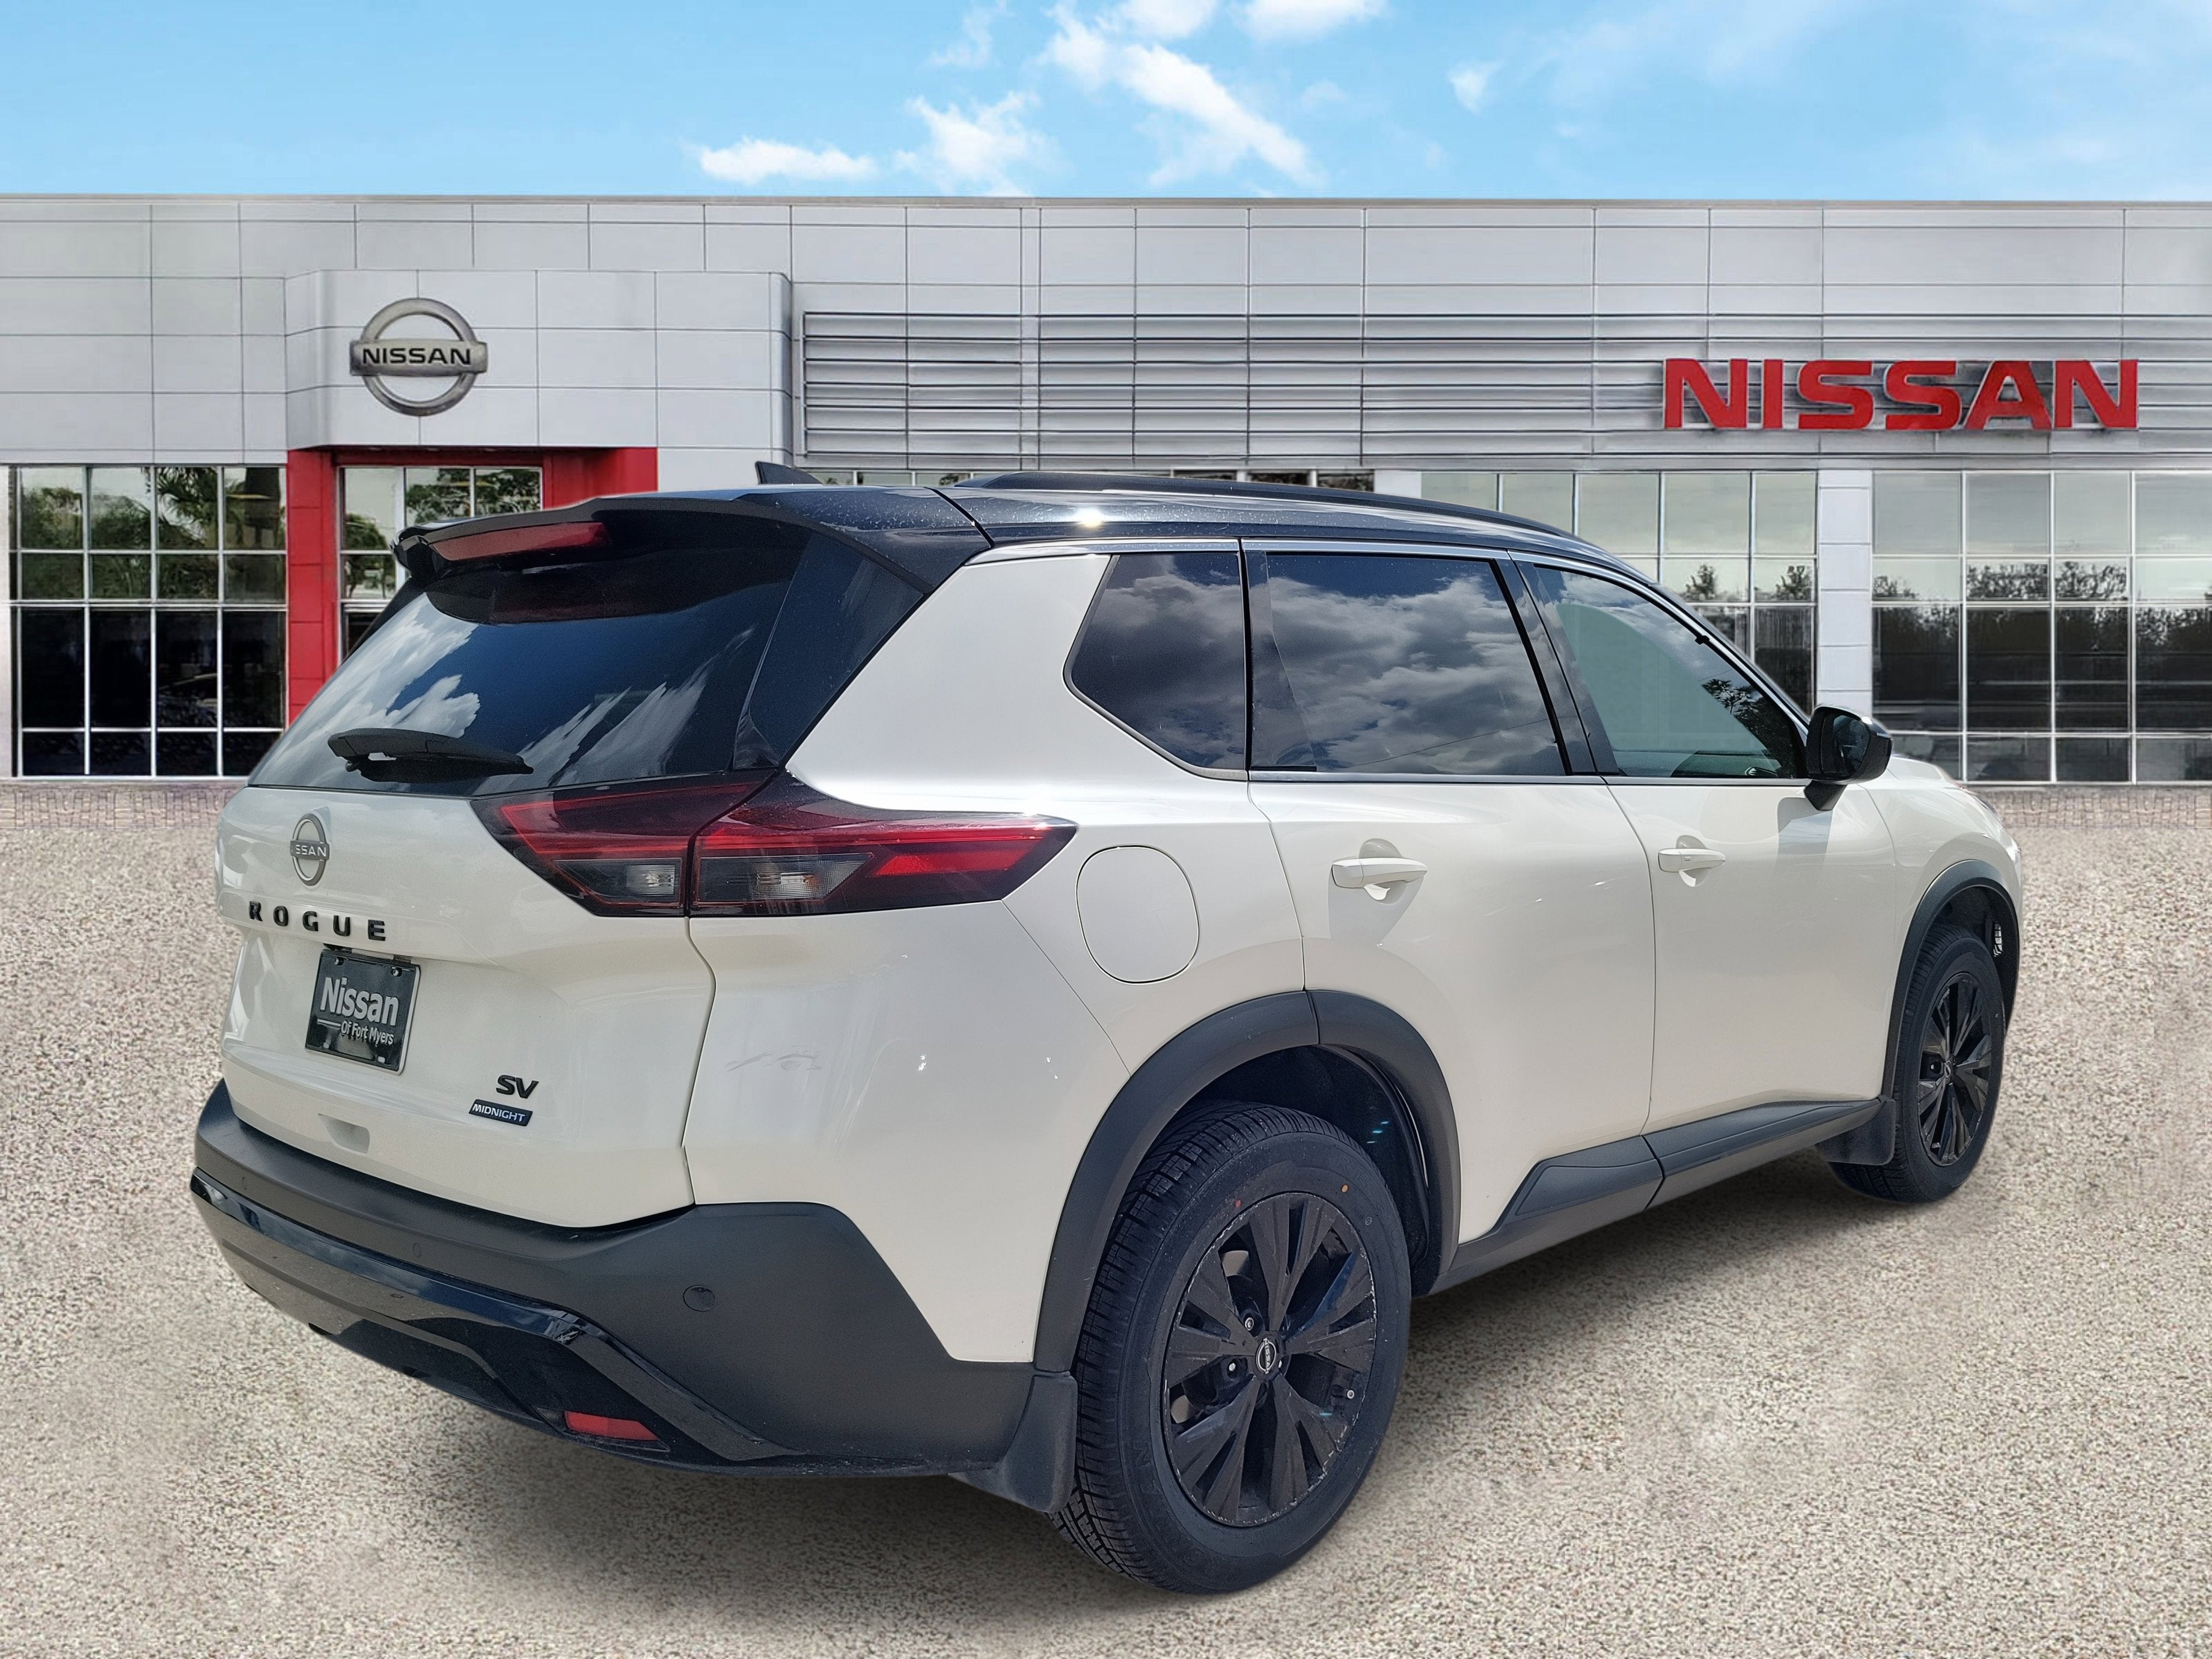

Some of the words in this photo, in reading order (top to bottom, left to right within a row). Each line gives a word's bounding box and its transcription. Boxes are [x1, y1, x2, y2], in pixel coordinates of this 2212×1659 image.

[363, 348, 471, 365] NISSAN
[1664, 357, 2139, 430] NISSAN
[249, 900, 386, 941] ROGUE
[320, 977, 399, 1026] Nissan
[341, 1020, 352, 1035] Of
[351, 1022, 368, 1039] Fort
[369, 1027, 394, 1047] Myers
[496, 1075, 539, 1099] SV
[472, 1104, 525, 1122] MIDNIGHT
